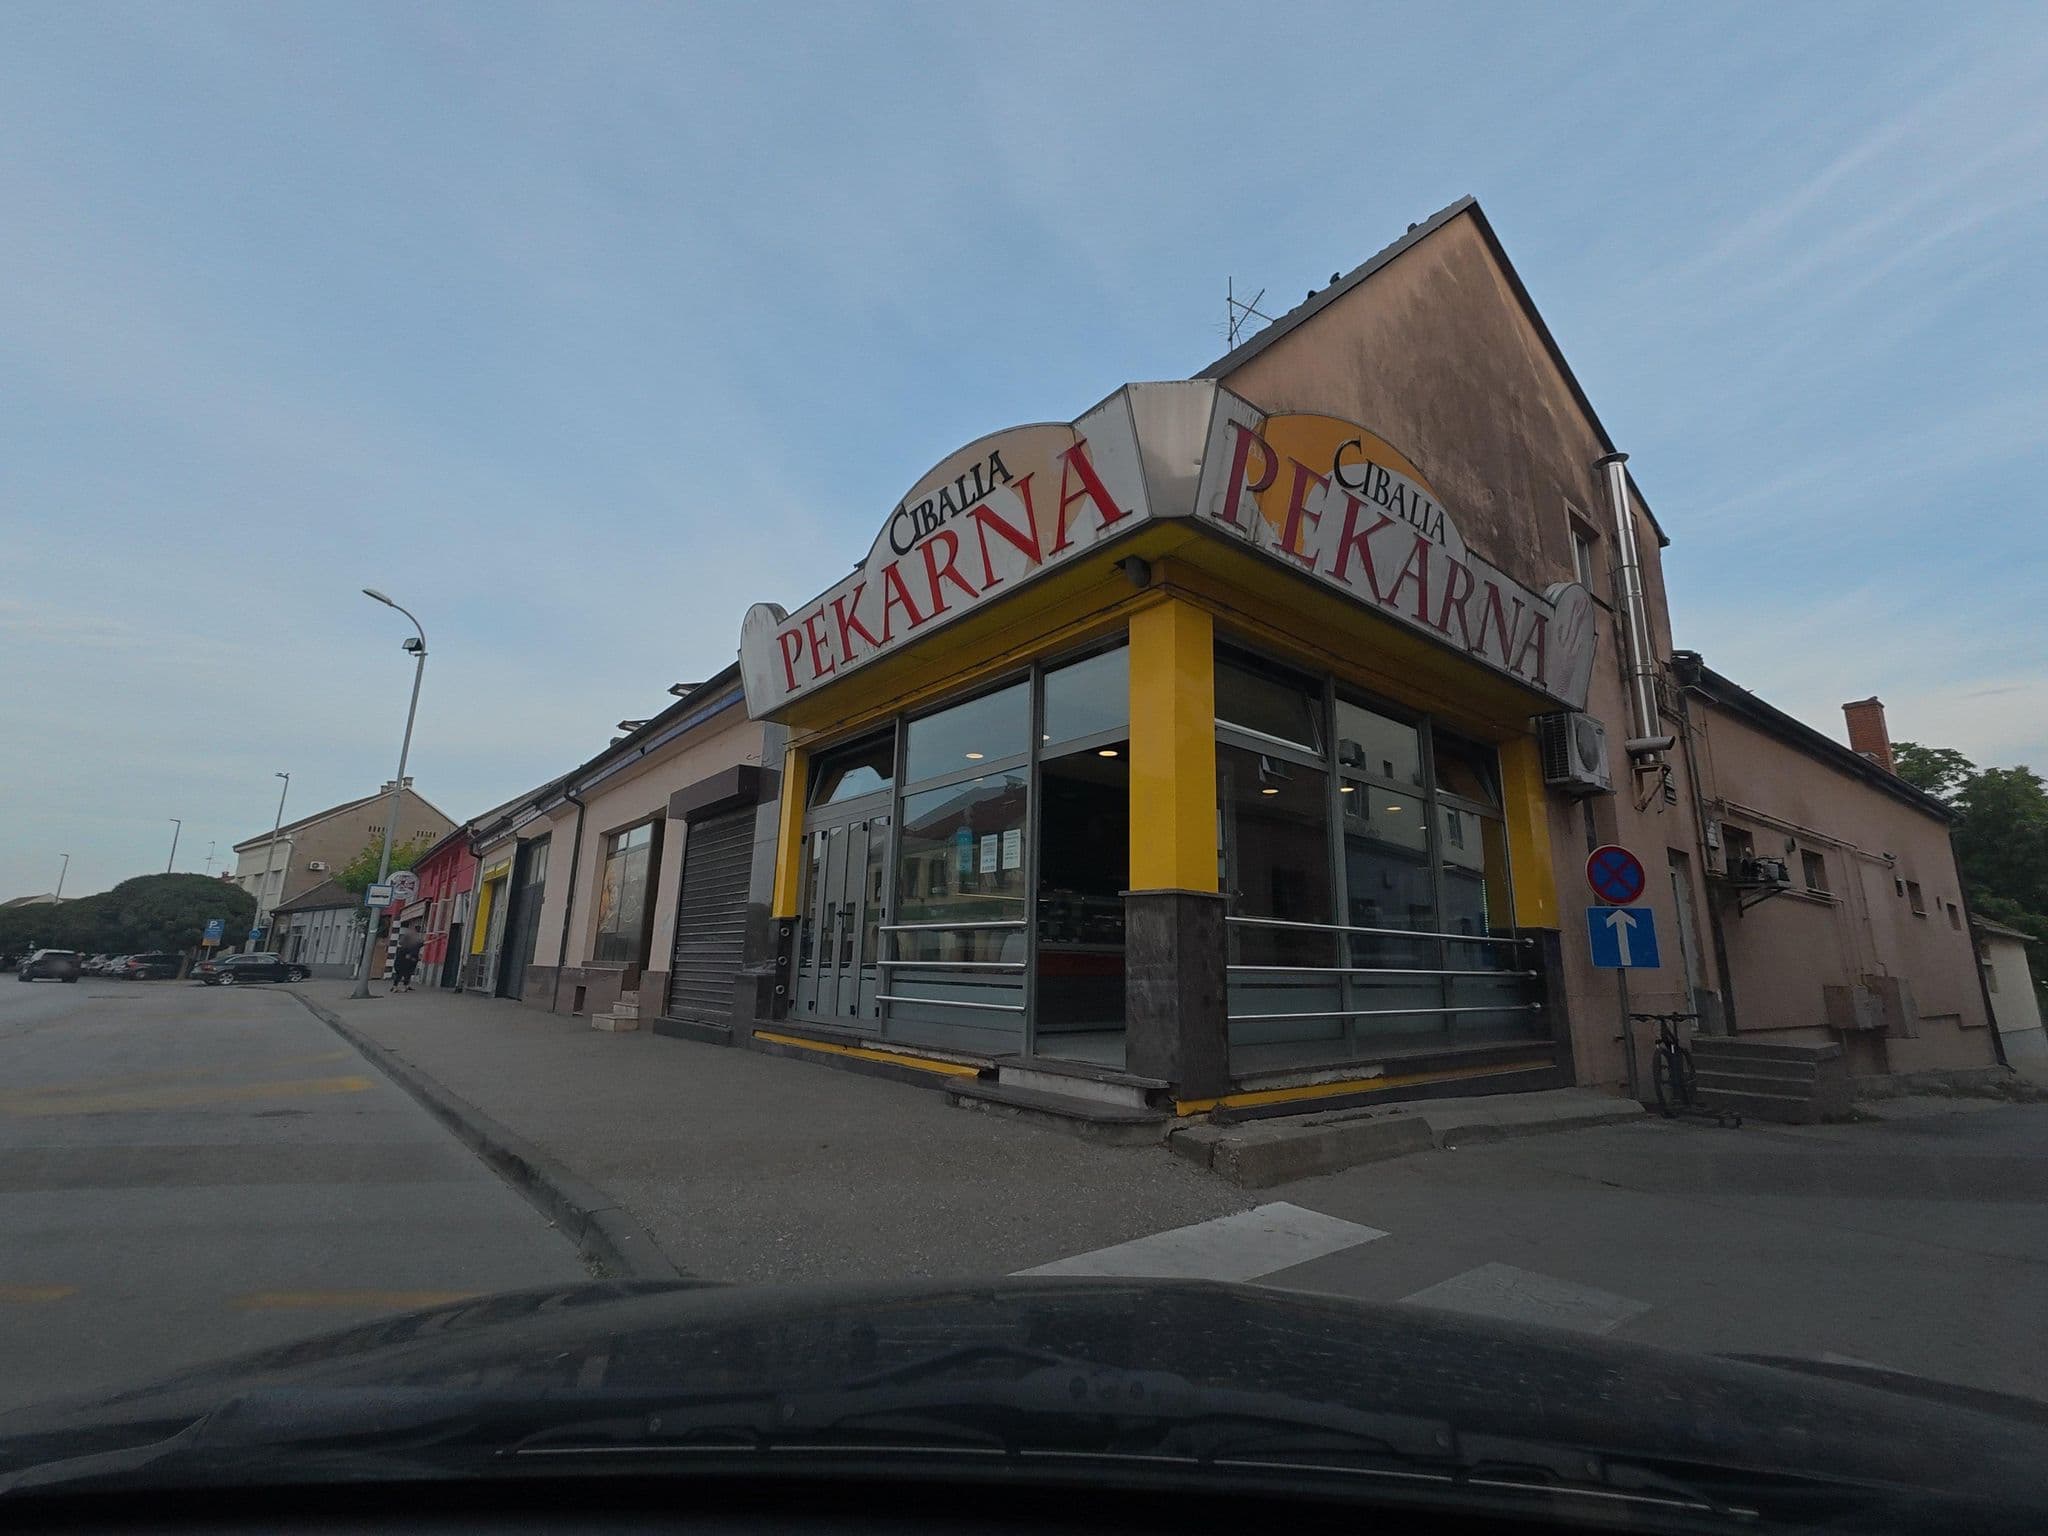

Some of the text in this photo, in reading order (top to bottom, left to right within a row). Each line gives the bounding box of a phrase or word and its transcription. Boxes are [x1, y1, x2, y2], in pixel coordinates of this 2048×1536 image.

[776, 438, 1133, 694] PEKARNA
[889, 449, 1014, 556] CIBALIA
[1211, 418, 1550, 687] PEKARNA
[1332, 435, 1447, 547] CIBALIA
